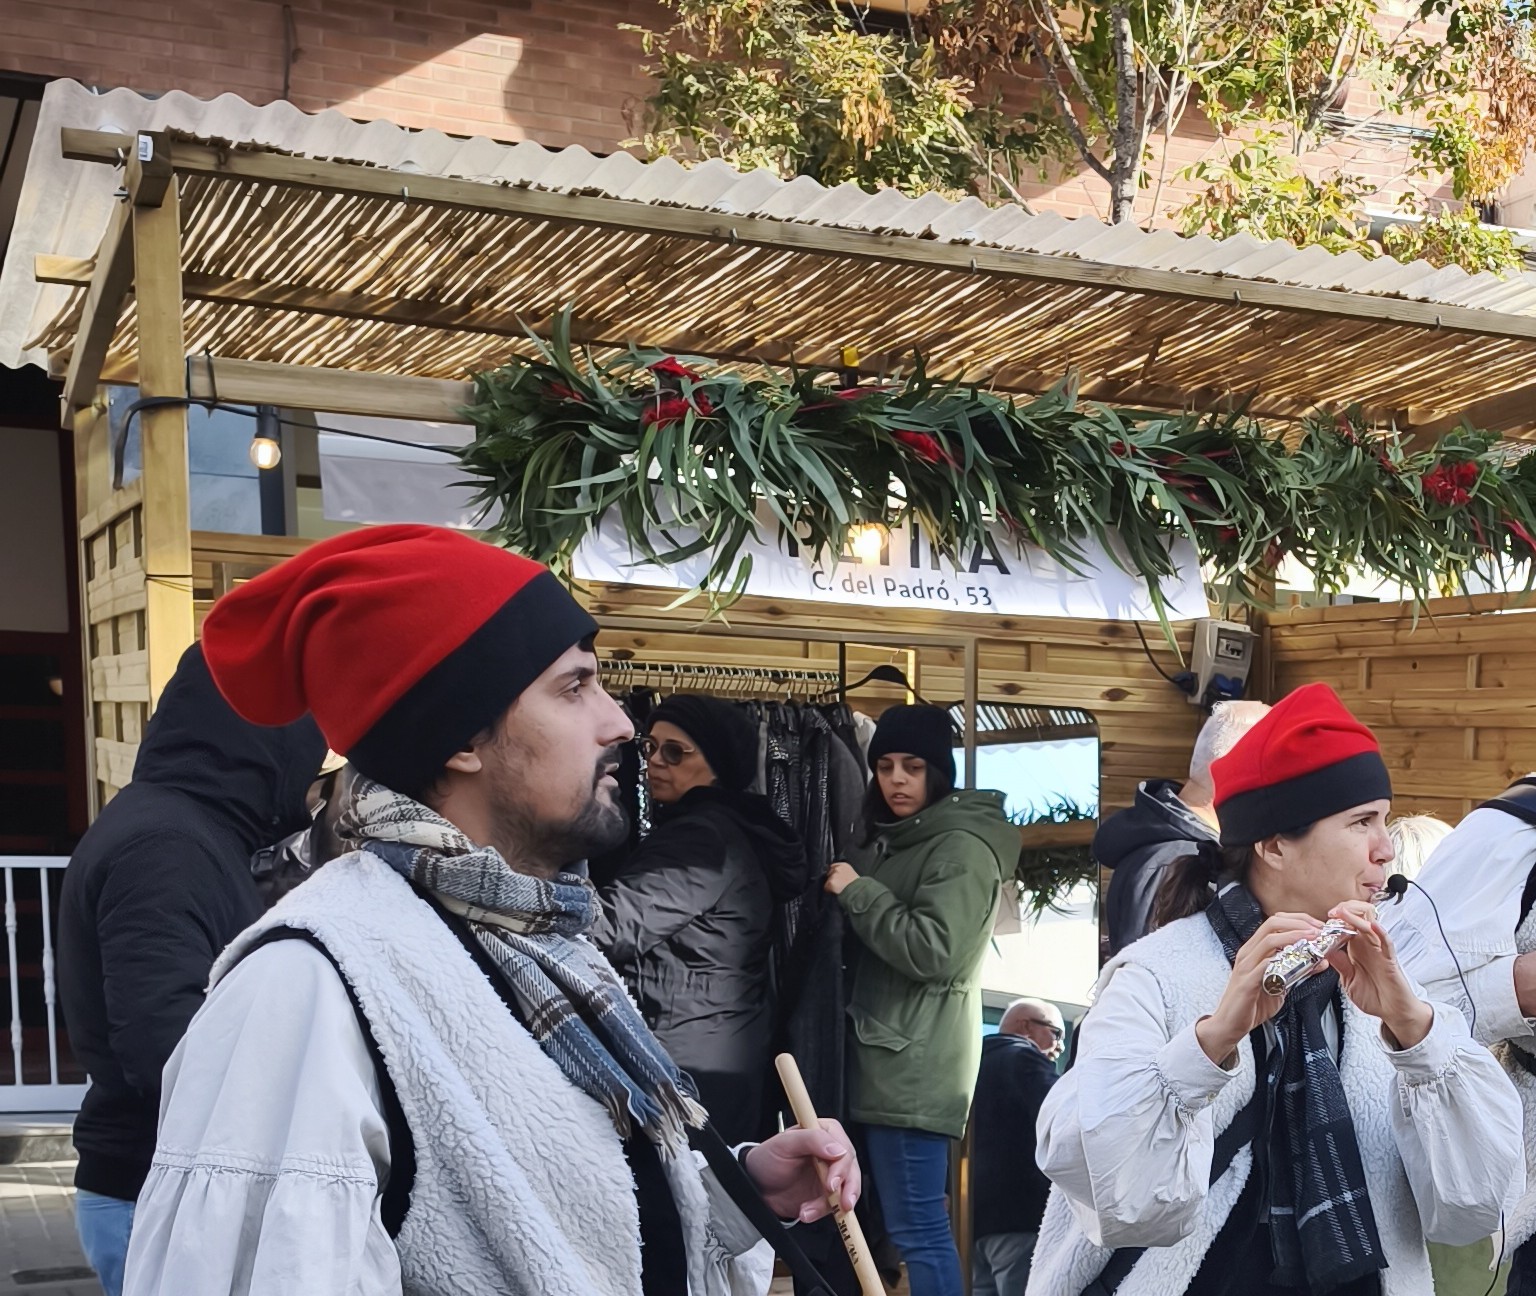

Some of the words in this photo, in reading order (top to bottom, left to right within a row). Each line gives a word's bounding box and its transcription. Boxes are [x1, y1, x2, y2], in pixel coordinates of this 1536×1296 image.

[812, 570, 833, 592] C.
[841, 572, 876, 596] del
[884, 578, 959, 606] Padró,
[966, 586, 992, 606] 53
